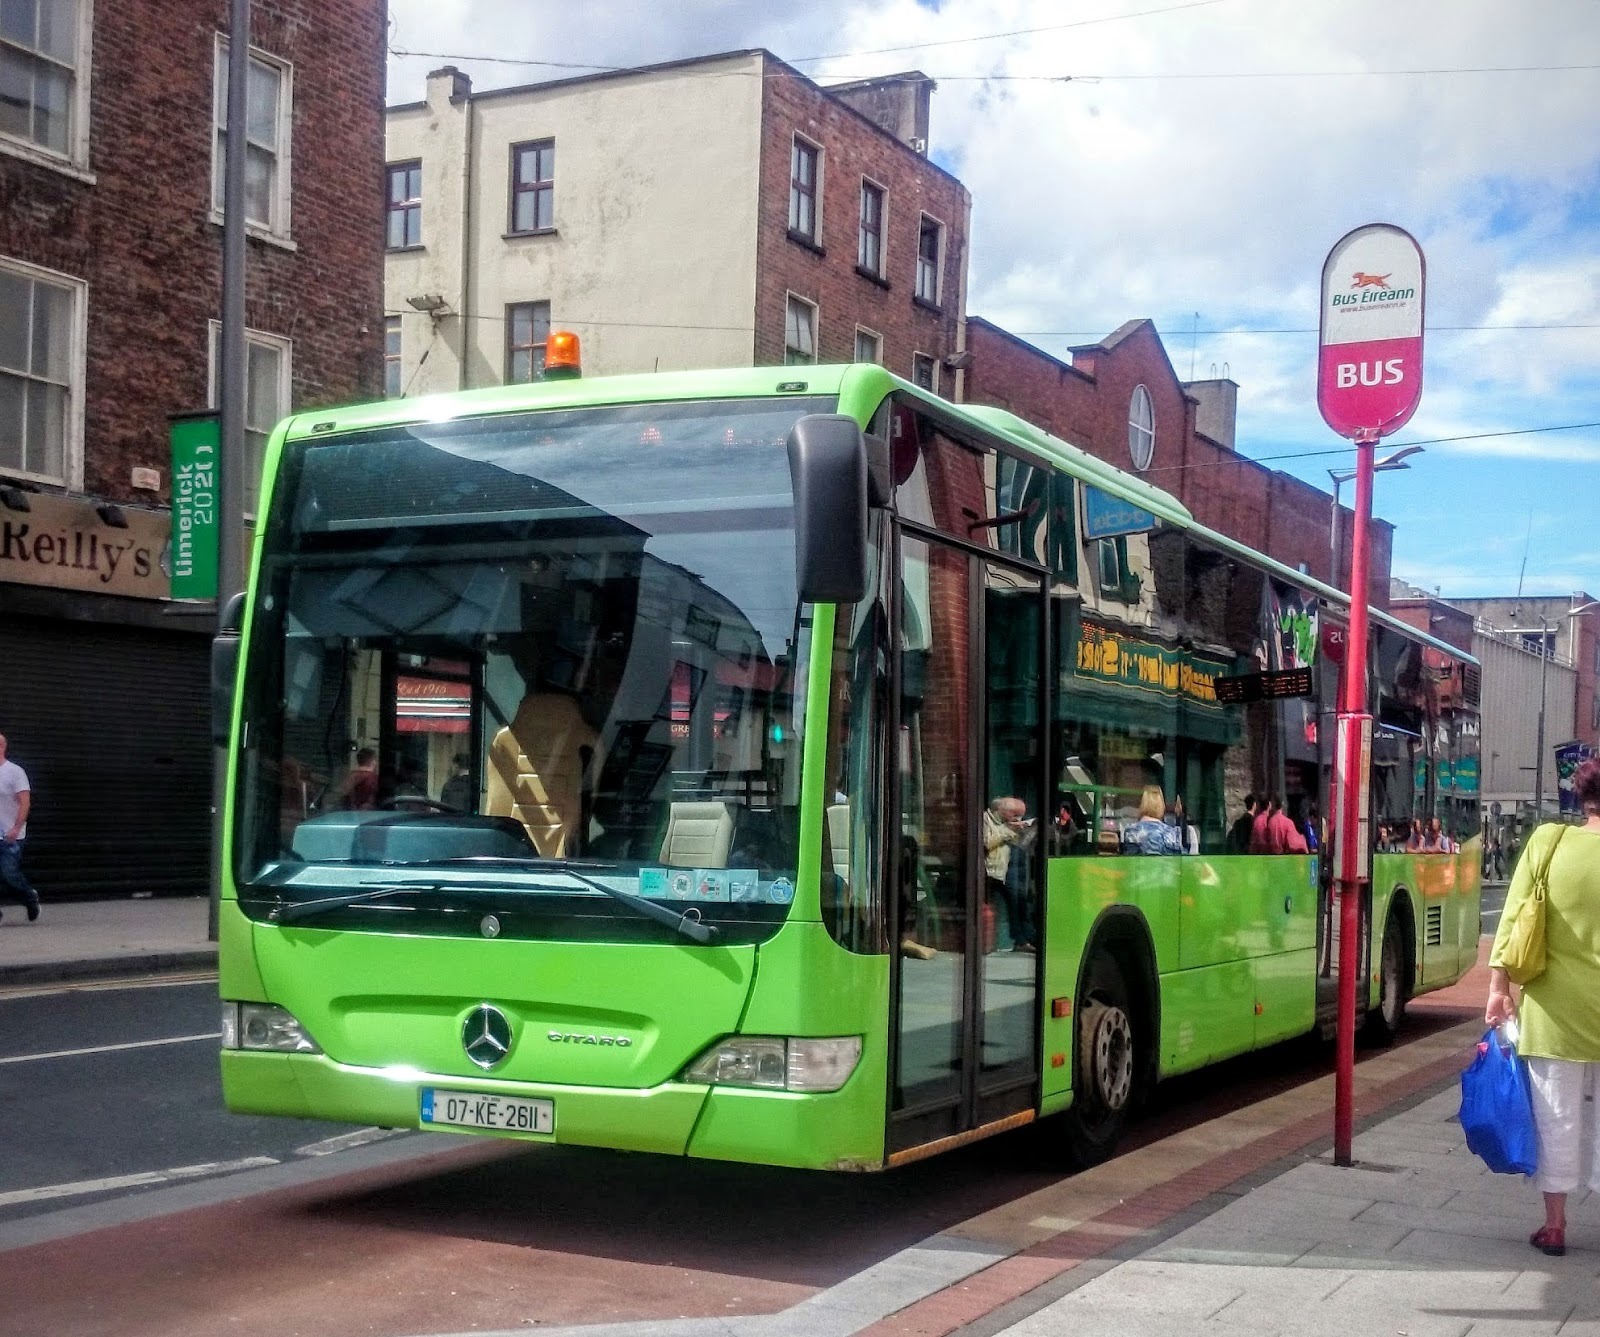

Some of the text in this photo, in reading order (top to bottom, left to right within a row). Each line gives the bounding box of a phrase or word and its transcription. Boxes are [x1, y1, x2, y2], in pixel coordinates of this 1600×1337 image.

[1332, 288, 1415, 306] Bus Éireann
[1337, 358, 1404, 389] BUS
[194, 445, 214, 525] 2020
[0, 521, 152, 583] Reilly's
[547, 1029, 633, 1047] CITARO
[447, 1098, 538, 1130] 07-KE-2611
